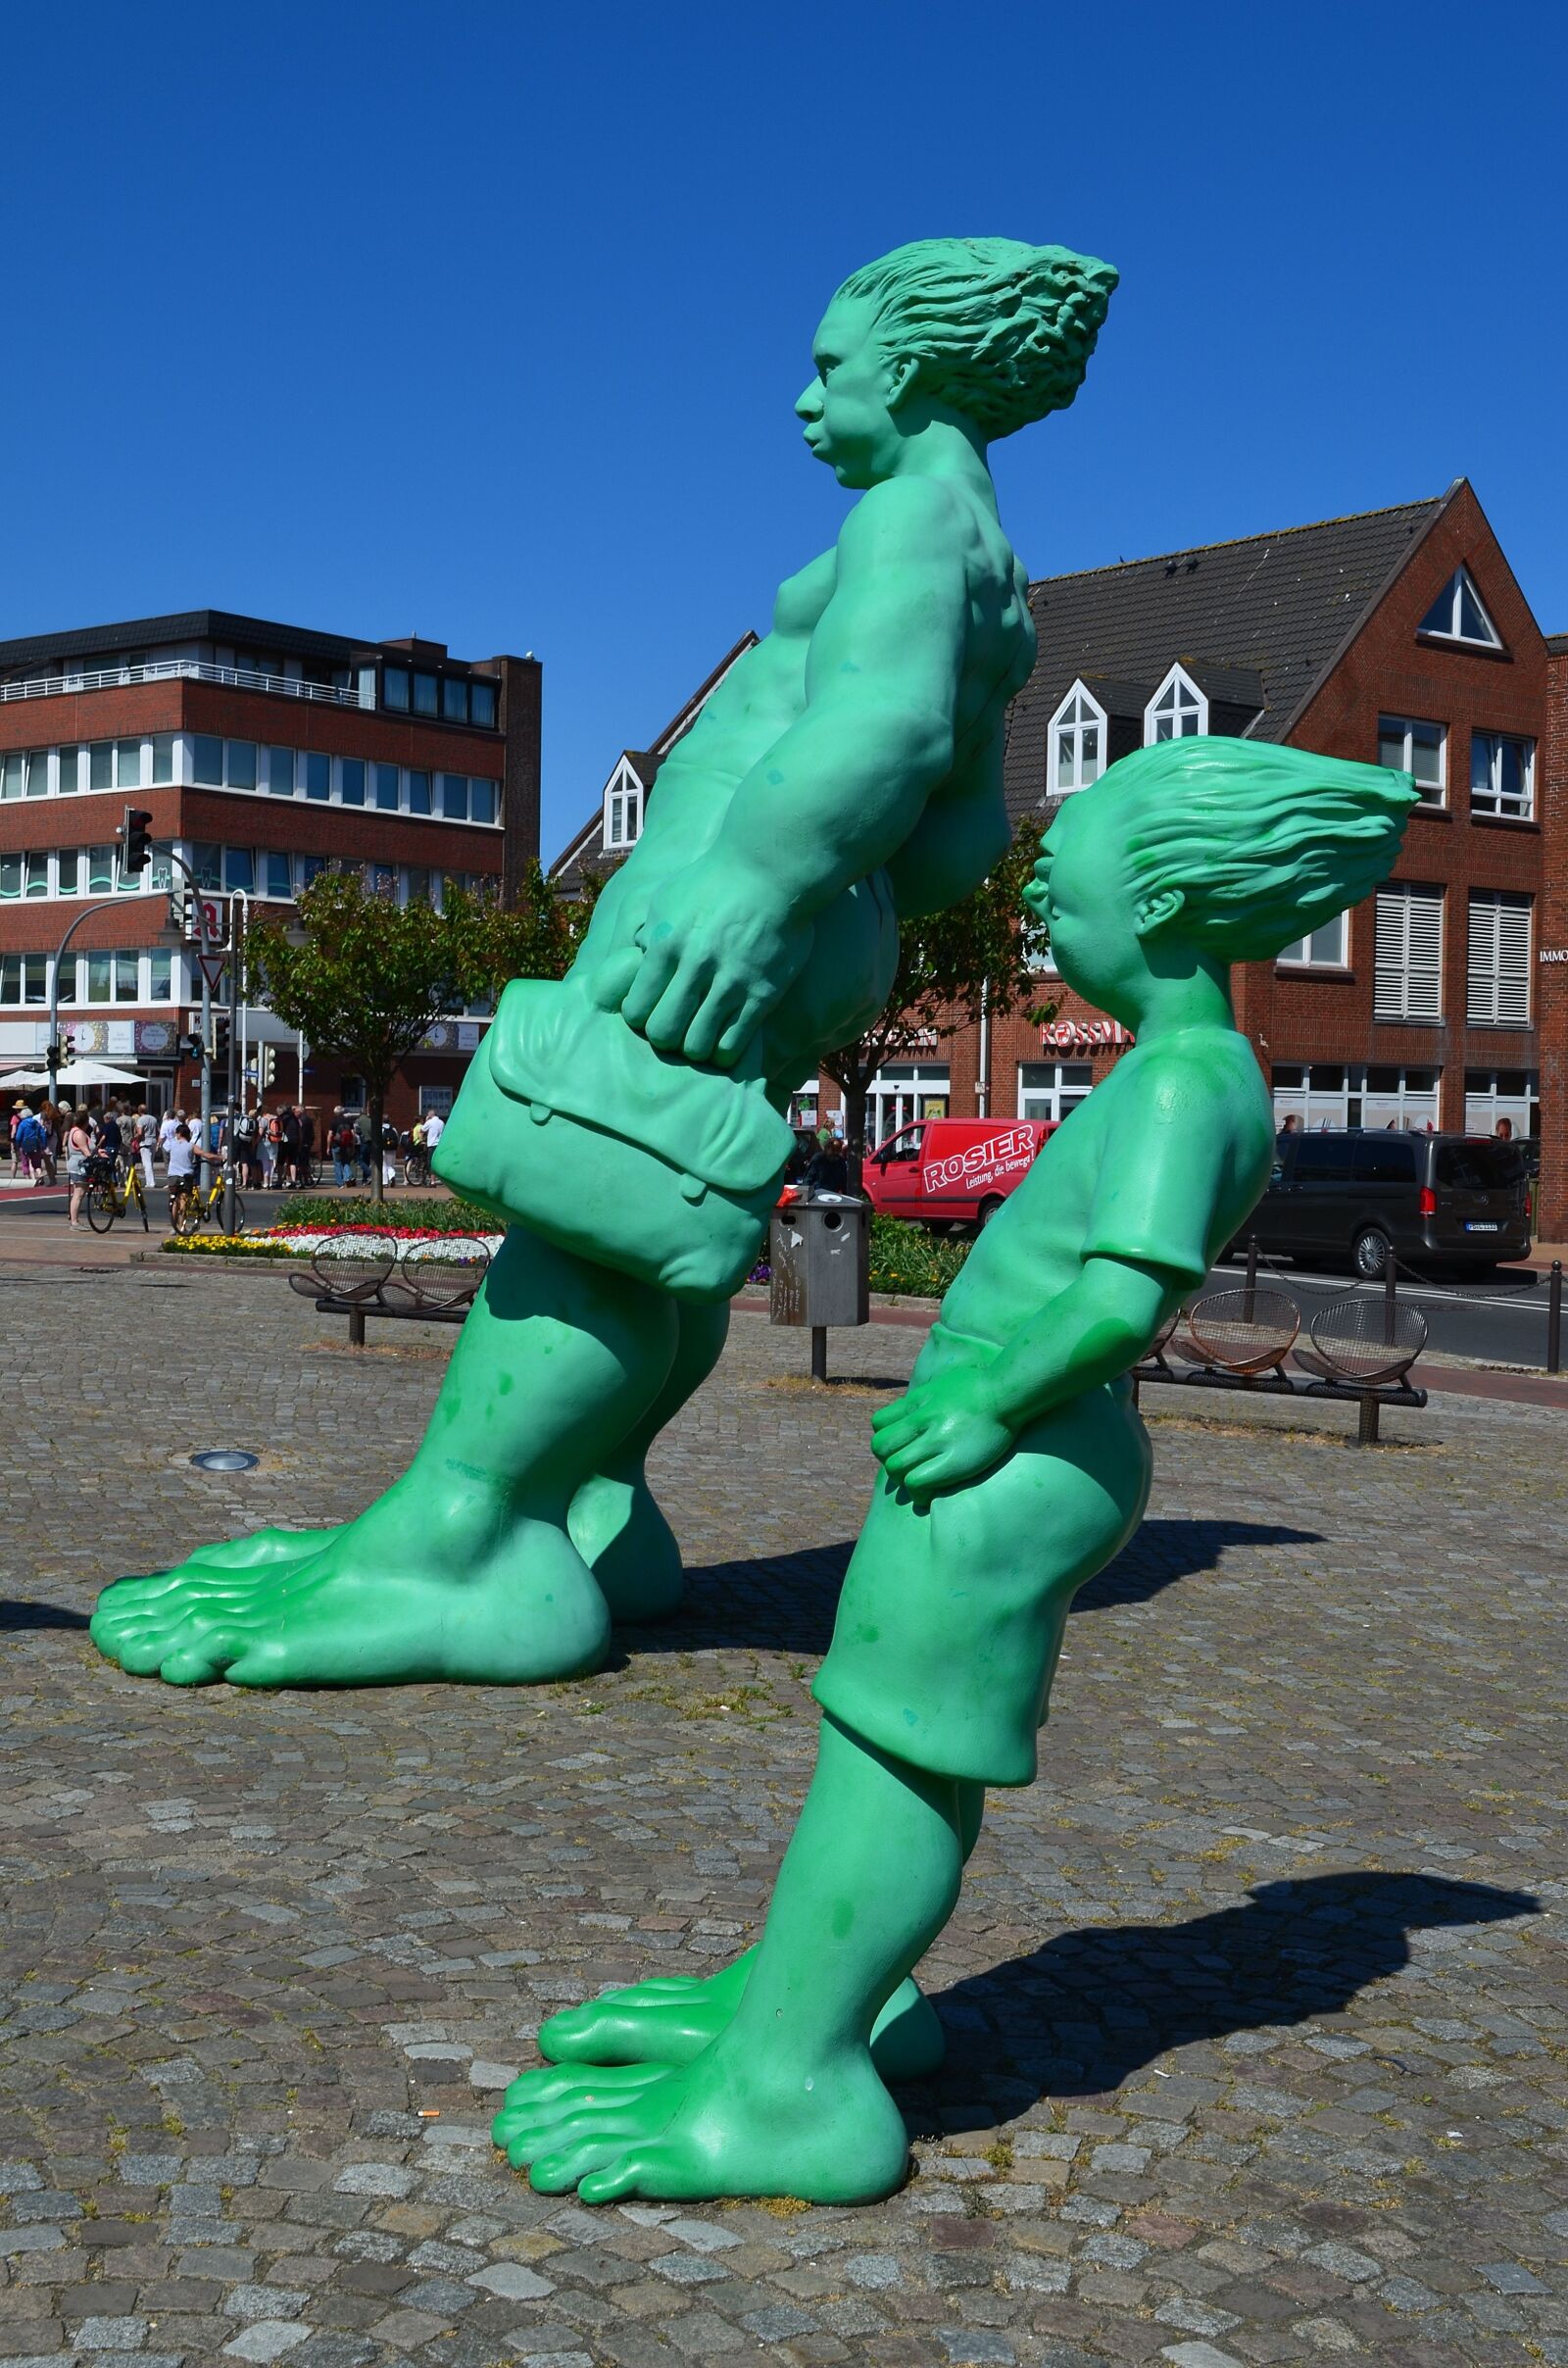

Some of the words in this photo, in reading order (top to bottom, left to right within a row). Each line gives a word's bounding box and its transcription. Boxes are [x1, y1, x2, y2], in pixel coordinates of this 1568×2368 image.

[923, 1124, 1035, 1193] ROSIER
[965, 1170, 994, 1190] Leistung,
[994, 1163, 1004, 1177] die
